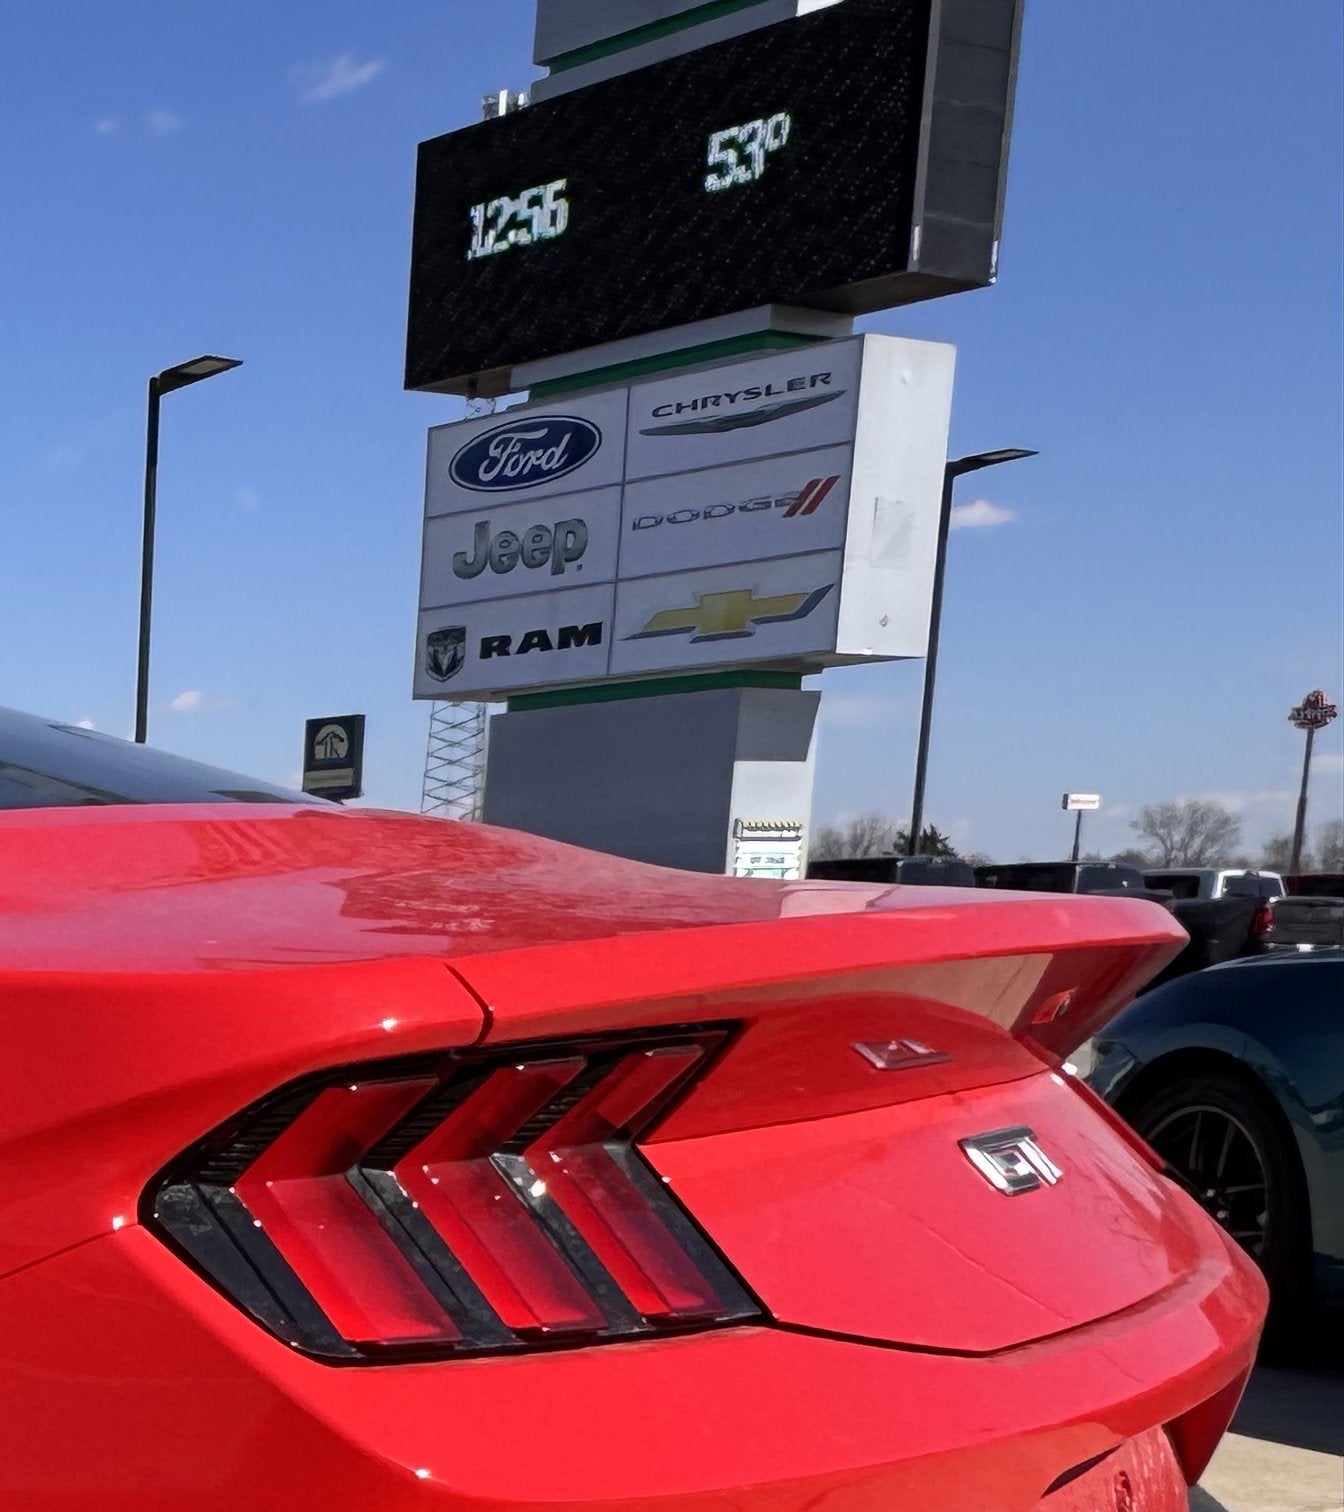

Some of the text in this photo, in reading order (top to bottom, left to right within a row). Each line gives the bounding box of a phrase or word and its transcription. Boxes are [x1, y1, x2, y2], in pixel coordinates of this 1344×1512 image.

[651, 370, 833, 419] CHRYSLER
[477, 426, 574, 482] Ford
[452, 517, 589, 579] Jeep
[478, 620, 604, 660] RAM
